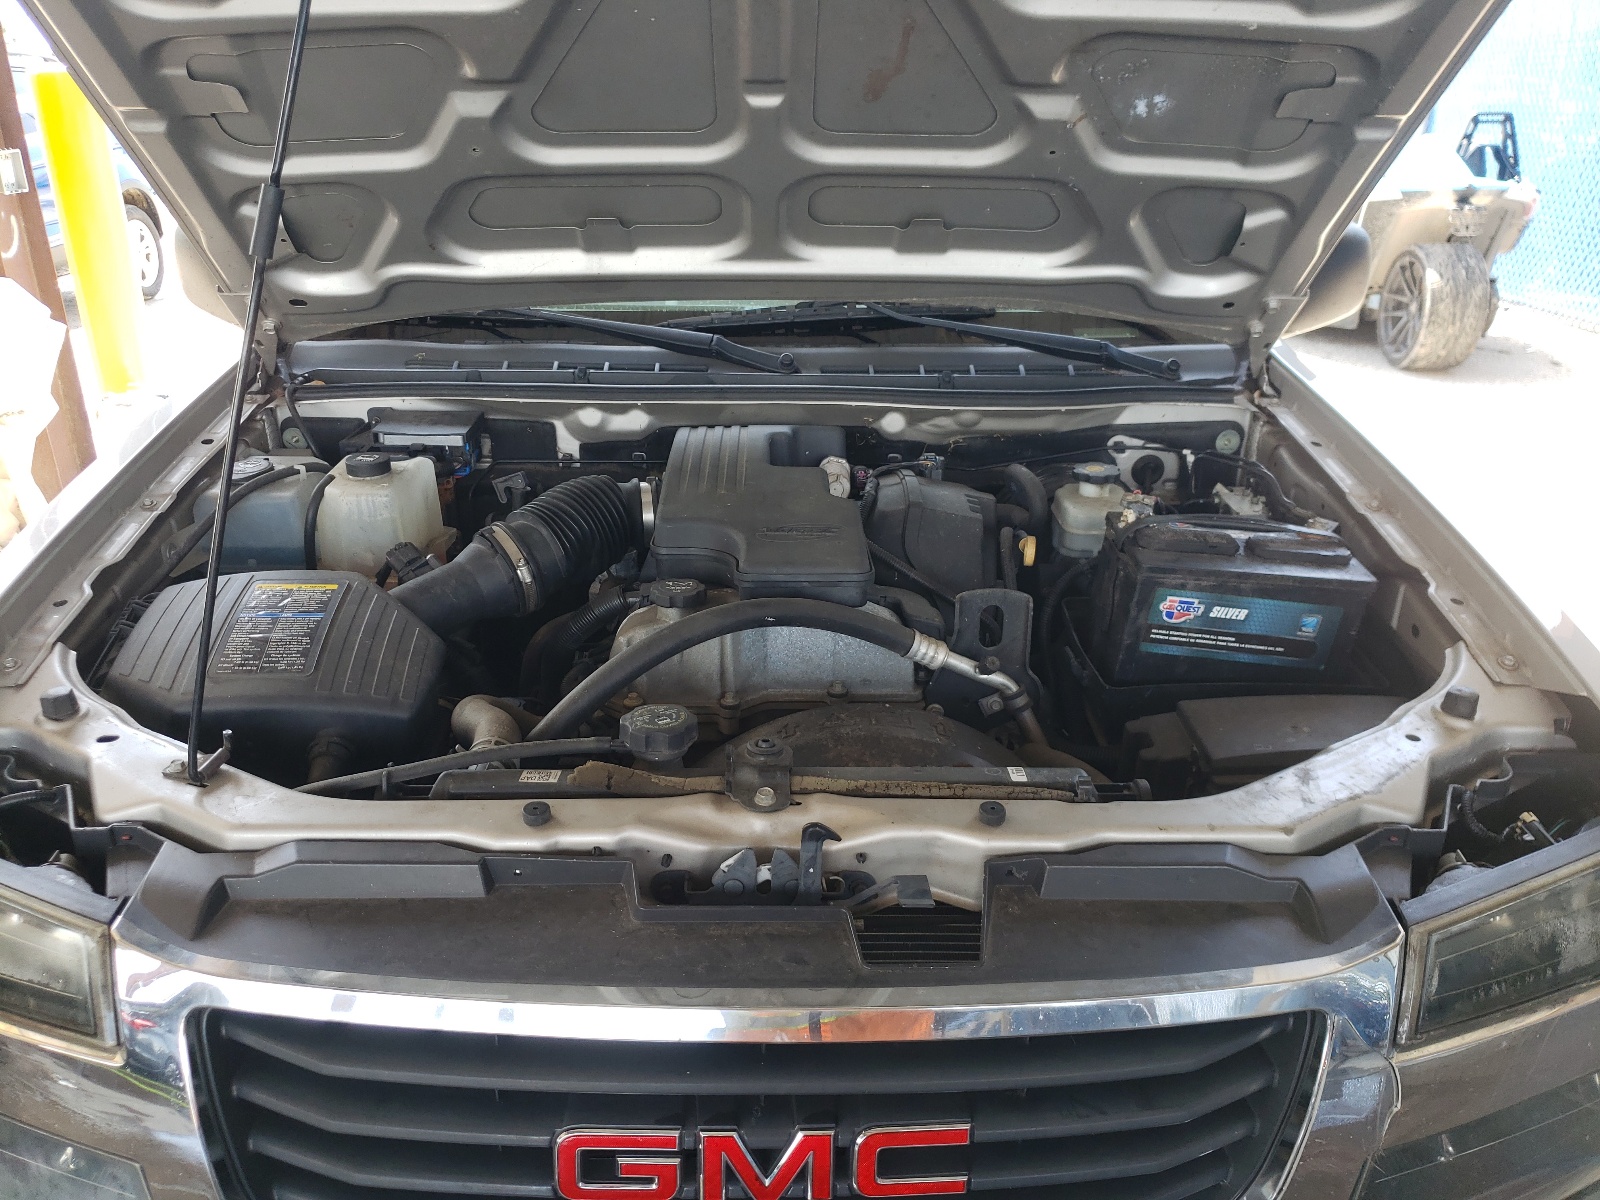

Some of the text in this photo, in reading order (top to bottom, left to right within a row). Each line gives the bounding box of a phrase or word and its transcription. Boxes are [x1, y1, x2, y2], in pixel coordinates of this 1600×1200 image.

[1162, 603, 1202, 614] CARQUEST
[1209, 606, 1249, 621] SILVER
[555, 1124, 971, 1200] GMC
